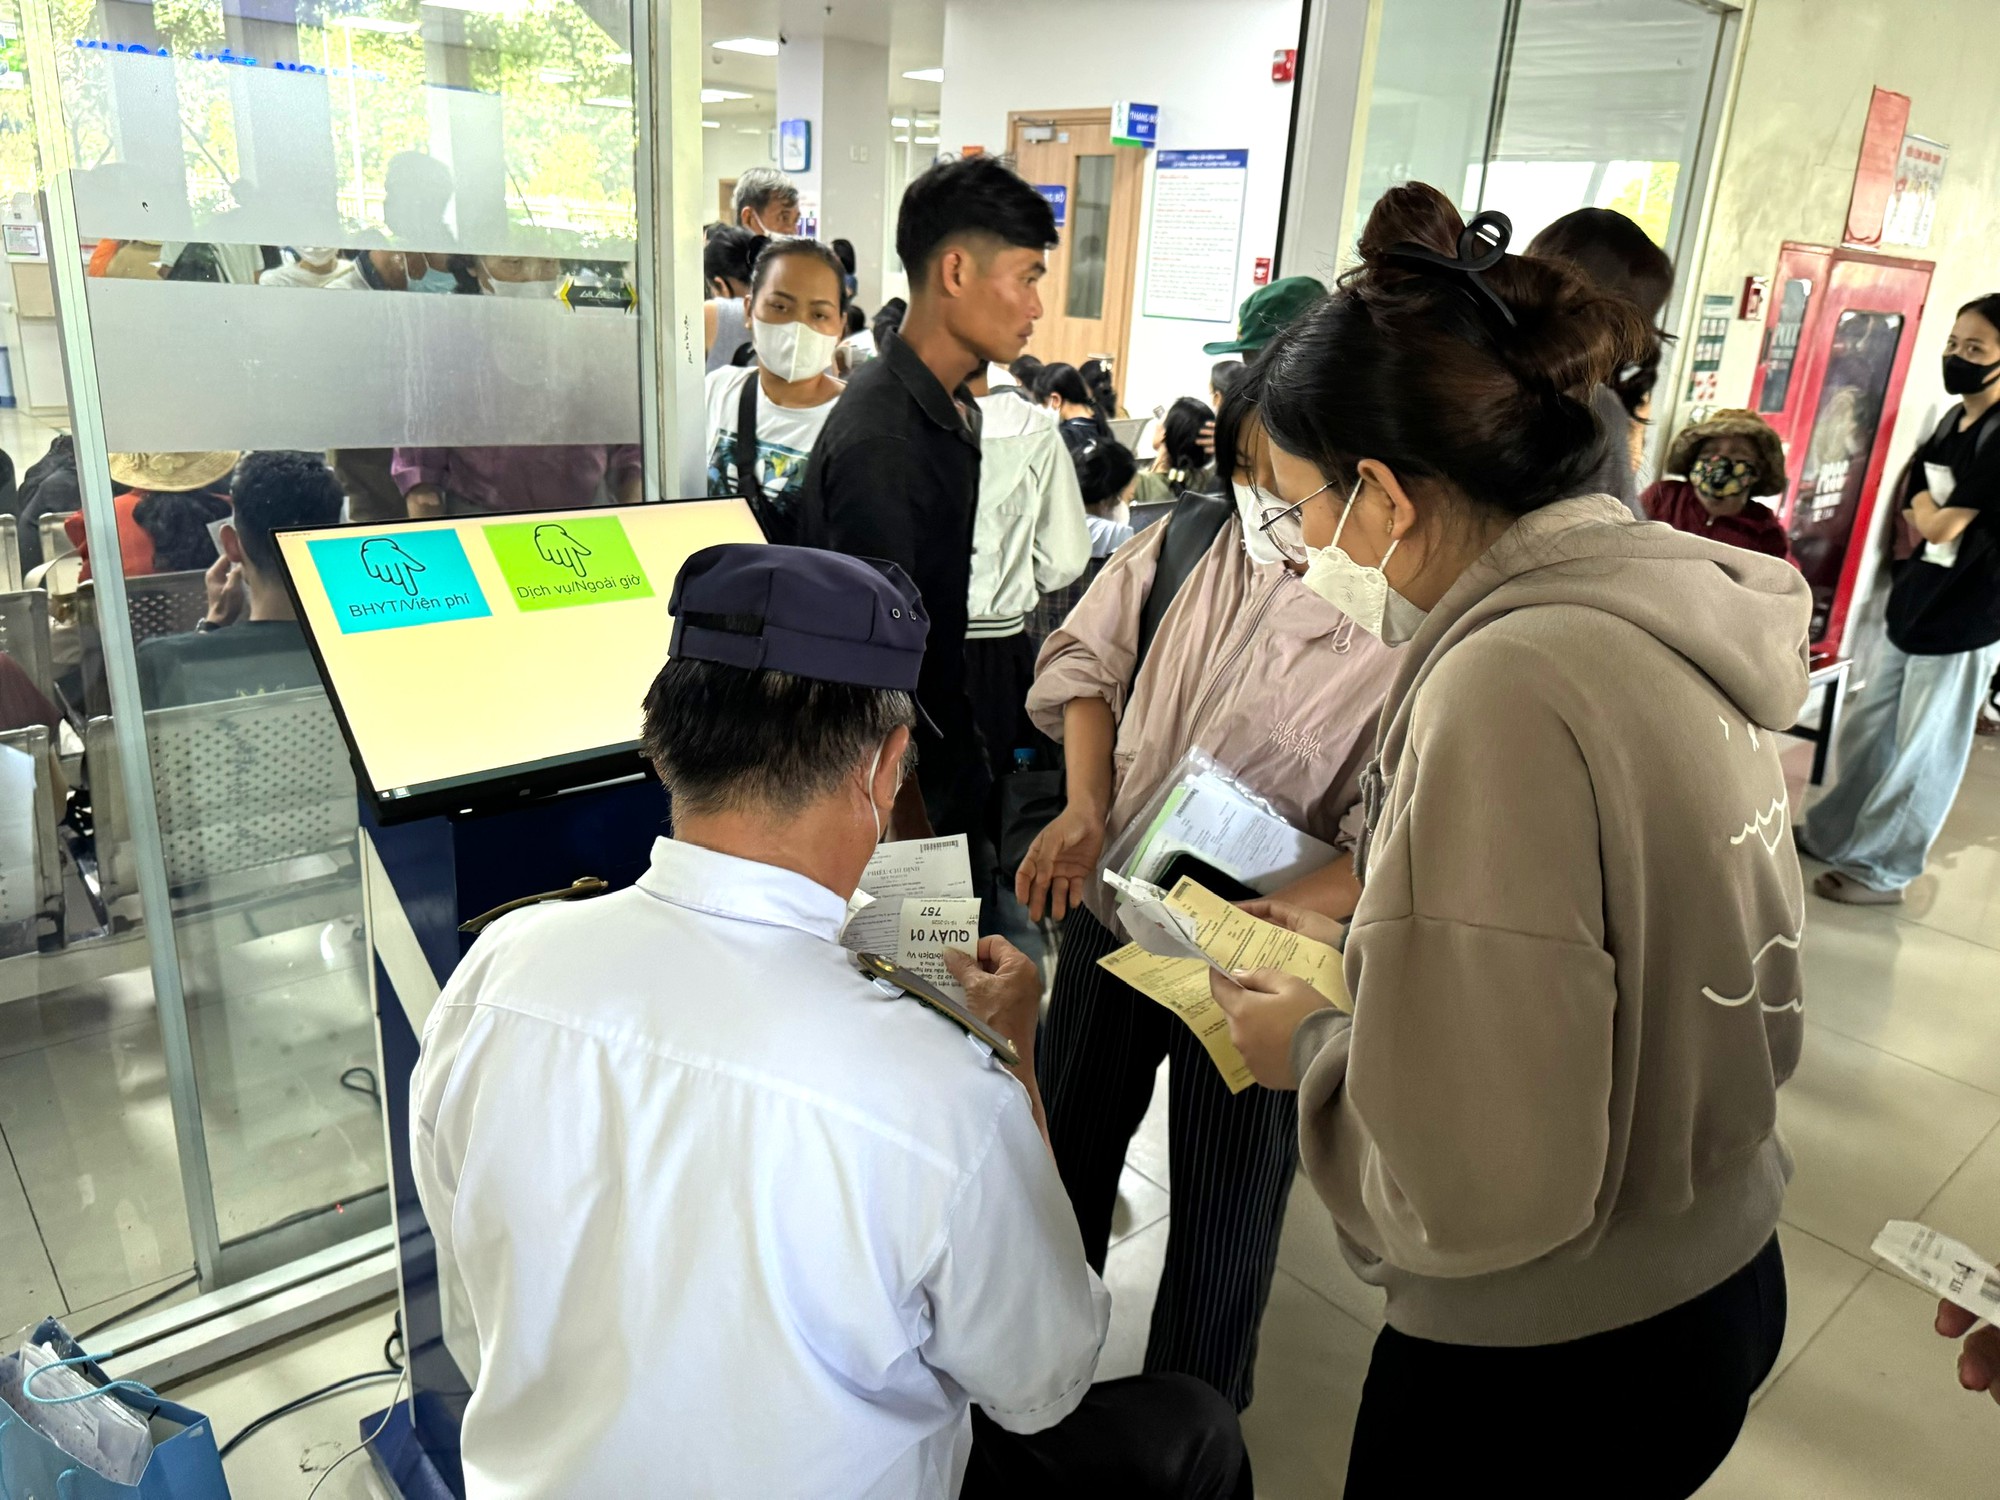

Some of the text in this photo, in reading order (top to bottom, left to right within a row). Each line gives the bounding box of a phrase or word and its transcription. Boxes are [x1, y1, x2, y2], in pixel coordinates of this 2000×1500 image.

[516, 573, 641, 599] Dịch vụ/Ngoài giờ
[348, 592, 470, 617] BHYT/Viện phí
[920, 906, 942, 917] 757
[910, 928, 925, 941] 01
